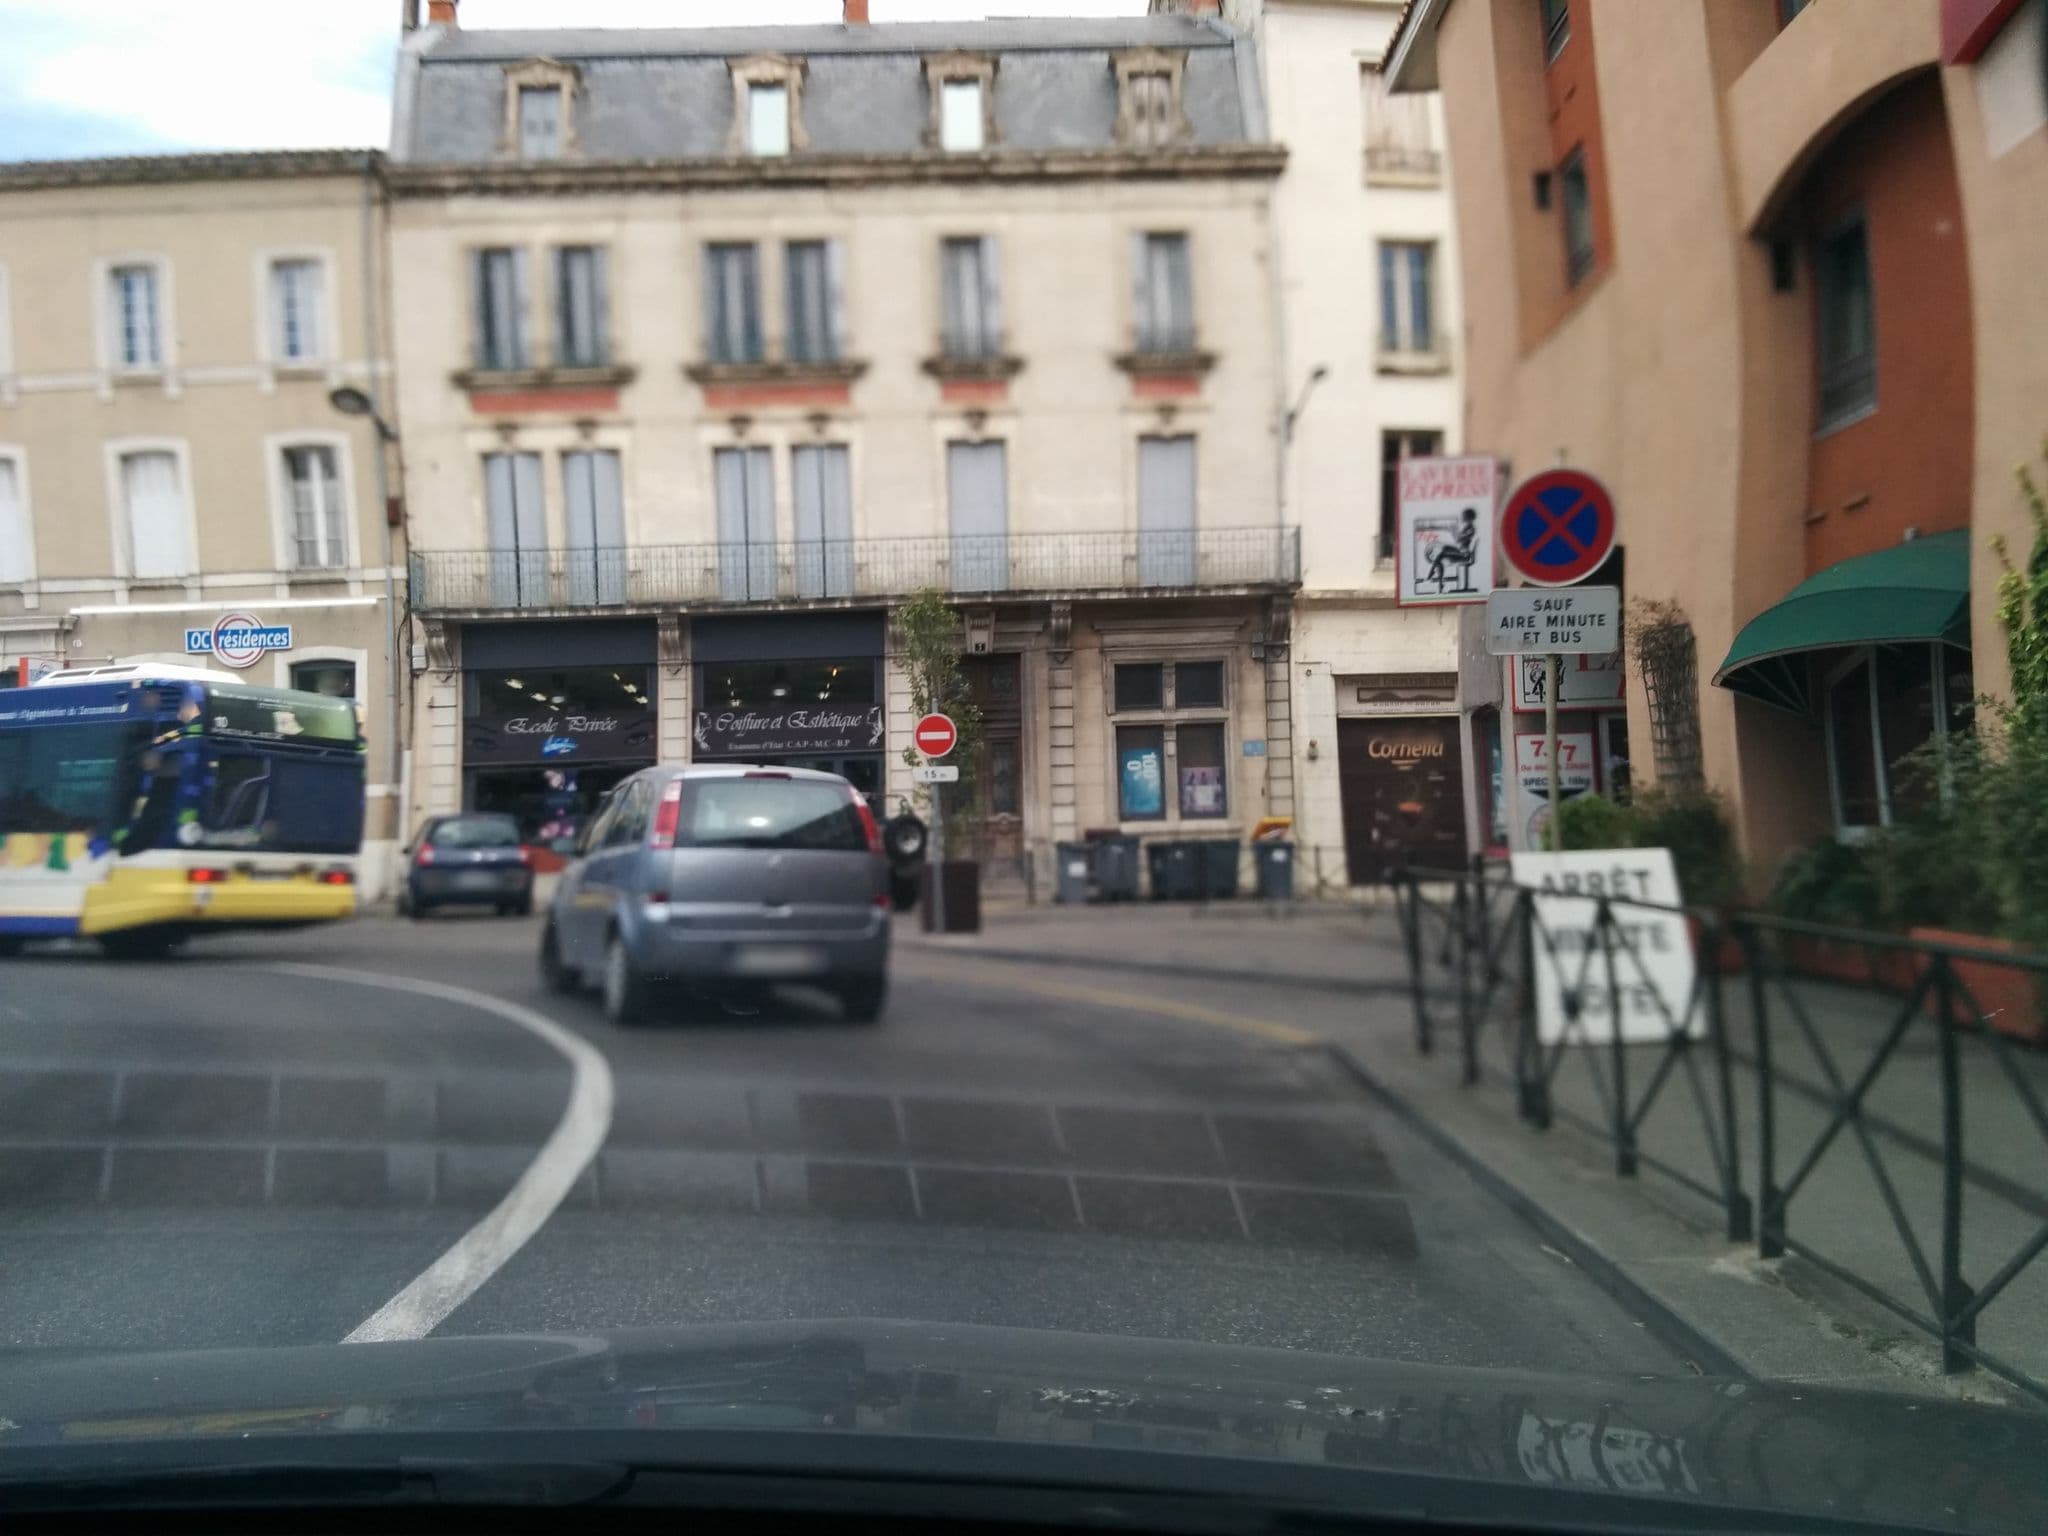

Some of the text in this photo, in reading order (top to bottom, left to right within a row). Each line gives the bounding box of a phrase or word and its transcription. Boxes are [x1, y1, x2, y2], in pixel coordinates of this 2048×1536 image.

[1533, 599, 1574, 612] SAUF
[1500, 614, 1606, 629] AIRE MINUTE
[190, 629, 288, 649] OC résidences
[1550, 631, 1582, 643] BUS
[504, 716, 618, 734] Ecole Privée
[716, 710, 863, 737] Coiffure et Esthétique
[924, 769, 938, 779] 15
[1541, 862, 1650, 900] ARRÊT
